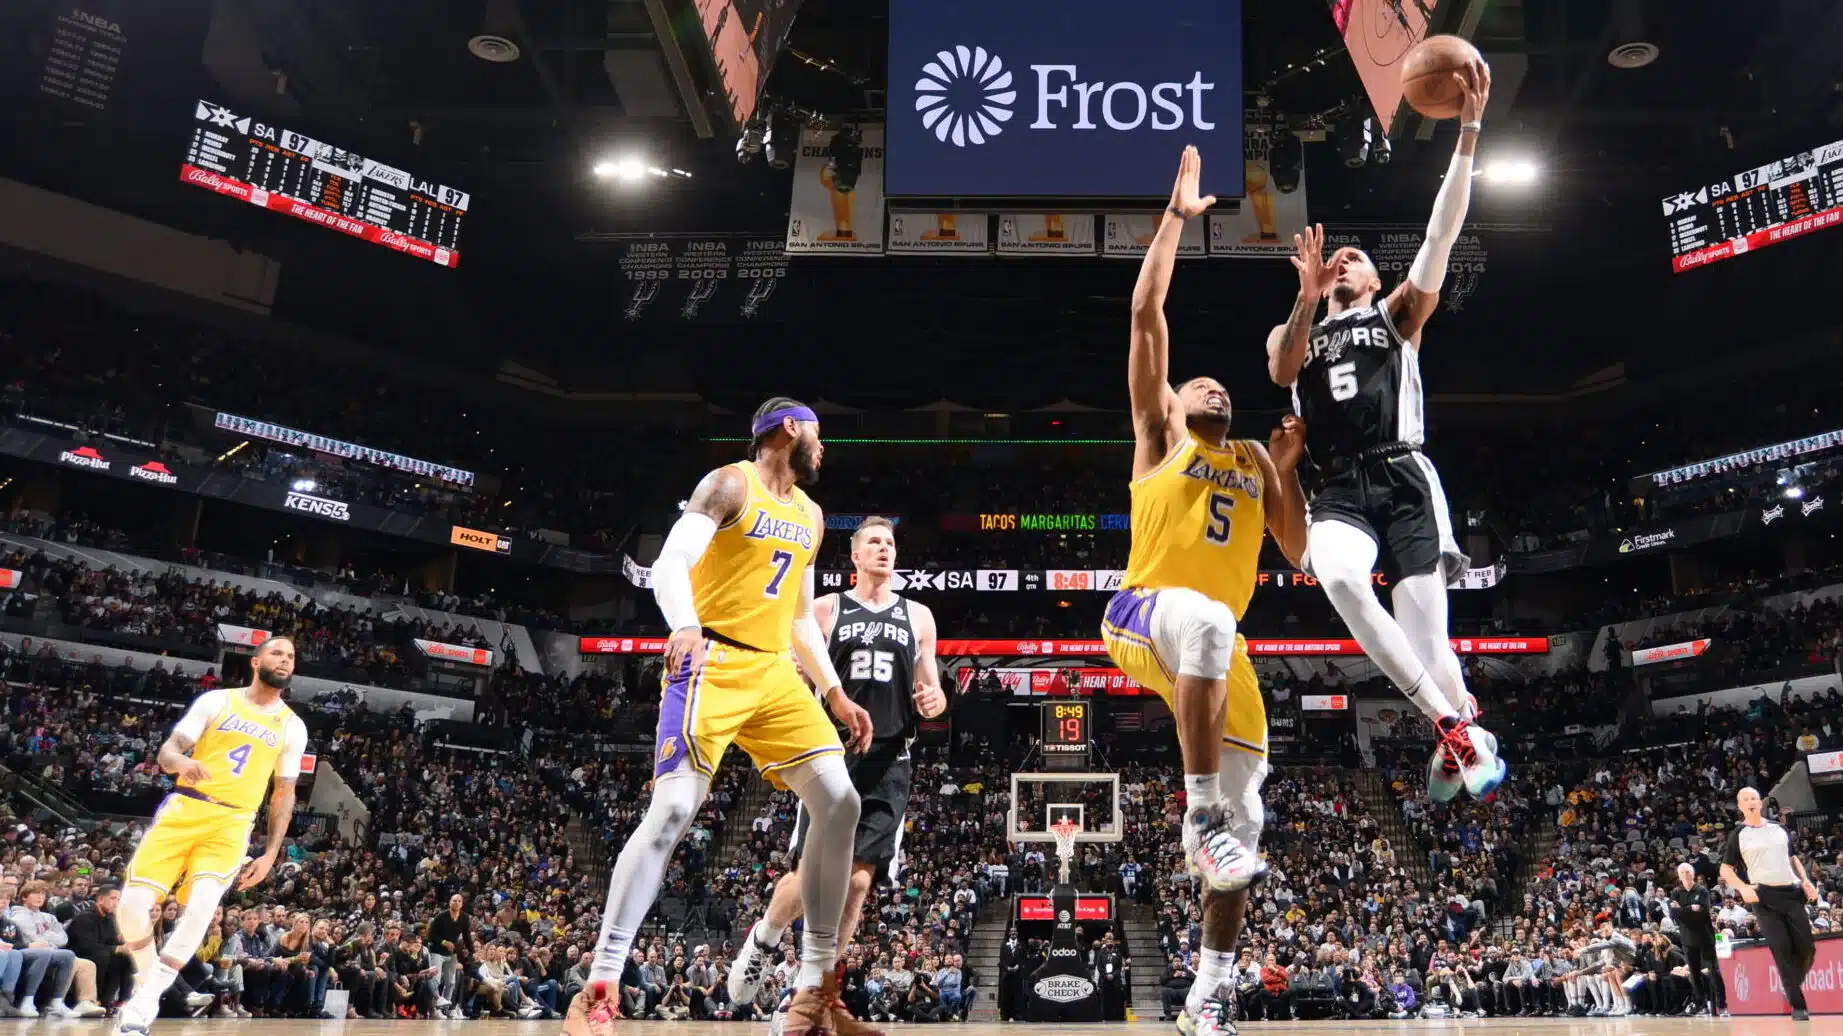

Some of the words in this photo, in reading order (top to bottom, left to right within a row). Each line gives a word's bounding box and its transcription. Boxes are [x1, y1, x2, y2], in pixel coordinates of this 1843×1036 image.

[80, 11, 121, 34] NBA
[1030, 64, 1215, 131] Frost
[254, 123, 275, 141] SA
[288, 134, 310, 153] 97
[803, 146, 882, 158] CHANS
[1821, 148, 1843, 164] LAK
[188, 170, 223, 190] Bally
[222, 183, 248, 197] SPORTS
[367, 164, 405, 187] LAKERS
[409, 177, 437, 197] LAL
[445, 188, 464, 207] 97
[1711, 181, 1731, 197] SA
[1741, 170, 1759, 188] 97
[291, 204, 304, 215] THE
[305, 208, 326, 223] HEART
[327, 214, 336, 225] OF
[336, 217, 349, 229] THE
[349, 221, 364, 234] FAN
[1769, 228, 1782, 240] THE
[1782, 223, 1802, 237] HEART
[1803, 219, 1813, 231] OF
[1813, 215, 1825, 228] THE
[1825, 211, 1840, 224] FAN
[380, 232, 410, 251] Bally
[409, 244, 432, 256] SPORTS
[692, 242, 727, 250] NBA
[752, 241, 785, 249] NBA
[1328, 235, 1360, 243] NBA
[1384, 234, 1420, 242] NBA
[1459, 235, 1480, 244] BA
[636, 243, 669, 251] NBA
[1679, 251, 1707, 268] Bally
[1706, 247, 1730, 259] SPORTS
[678, 269, 727, 279] 2003
[737, 268, 786, 278] 2005
[1379, 262, 1411, 271] 201
[1451, 263, 1486, 273] 014
[625, 270, 669, 280] 1999
[1328, 361, 1359, 402] 5
[60, 451, 89, 465] Pizza
[89, 457, 111, 470] Hut
[130, 465, 157, 480] Pizza
[157, 472, 178, 484] Hut
[1180, 454, 1259, 499] LAKERS
[980, 514, 1016, 530] TACOS
[1021, 514, 1096, 530] MARGARITAS
[1101, 514, 1129, 530] CERV
[1205, 492, 1235, 546] 5
[744, 509, 812, 550] LAKERS
[1634, 528, 1675, 544] Firstmark
[459, 532, 493, 545] HOLT
[497, 540, 511, 550] CAT
[765, 549, 793, 597] 7
[823, 573, 841, 587] 54.9
[947, 572, 973, 588] SA
[988, 573, 1007, 590] 97
[1025, 574, 1039, 582] 4th
[1054, 572, 1088, 590] 8:49
[1258, 573, 1268, 584] F
[596, 640, 619, 650] Bally
[1016, 641, 1039, 652] Bally
[850, 650, 895, 682] 25
[1001, 671, 1022, 690] lly
[1083, 676, 1110, 688] HEART
[1112, 676, 1125, 688] OF
[1055, 705, 1083, 718] 8:49
[216, 714, 278, 747] LAKERS
[1059, 718, 1079, 741] 19
[1270, 717, 1294, 728] BUMS
[227, 743, 253, 775] 4
[1052, 947, 1077, 957] odoo
[1048, 980, 1080, 988] BRAKE
[1047, 989, 1080, 997] CHECK
